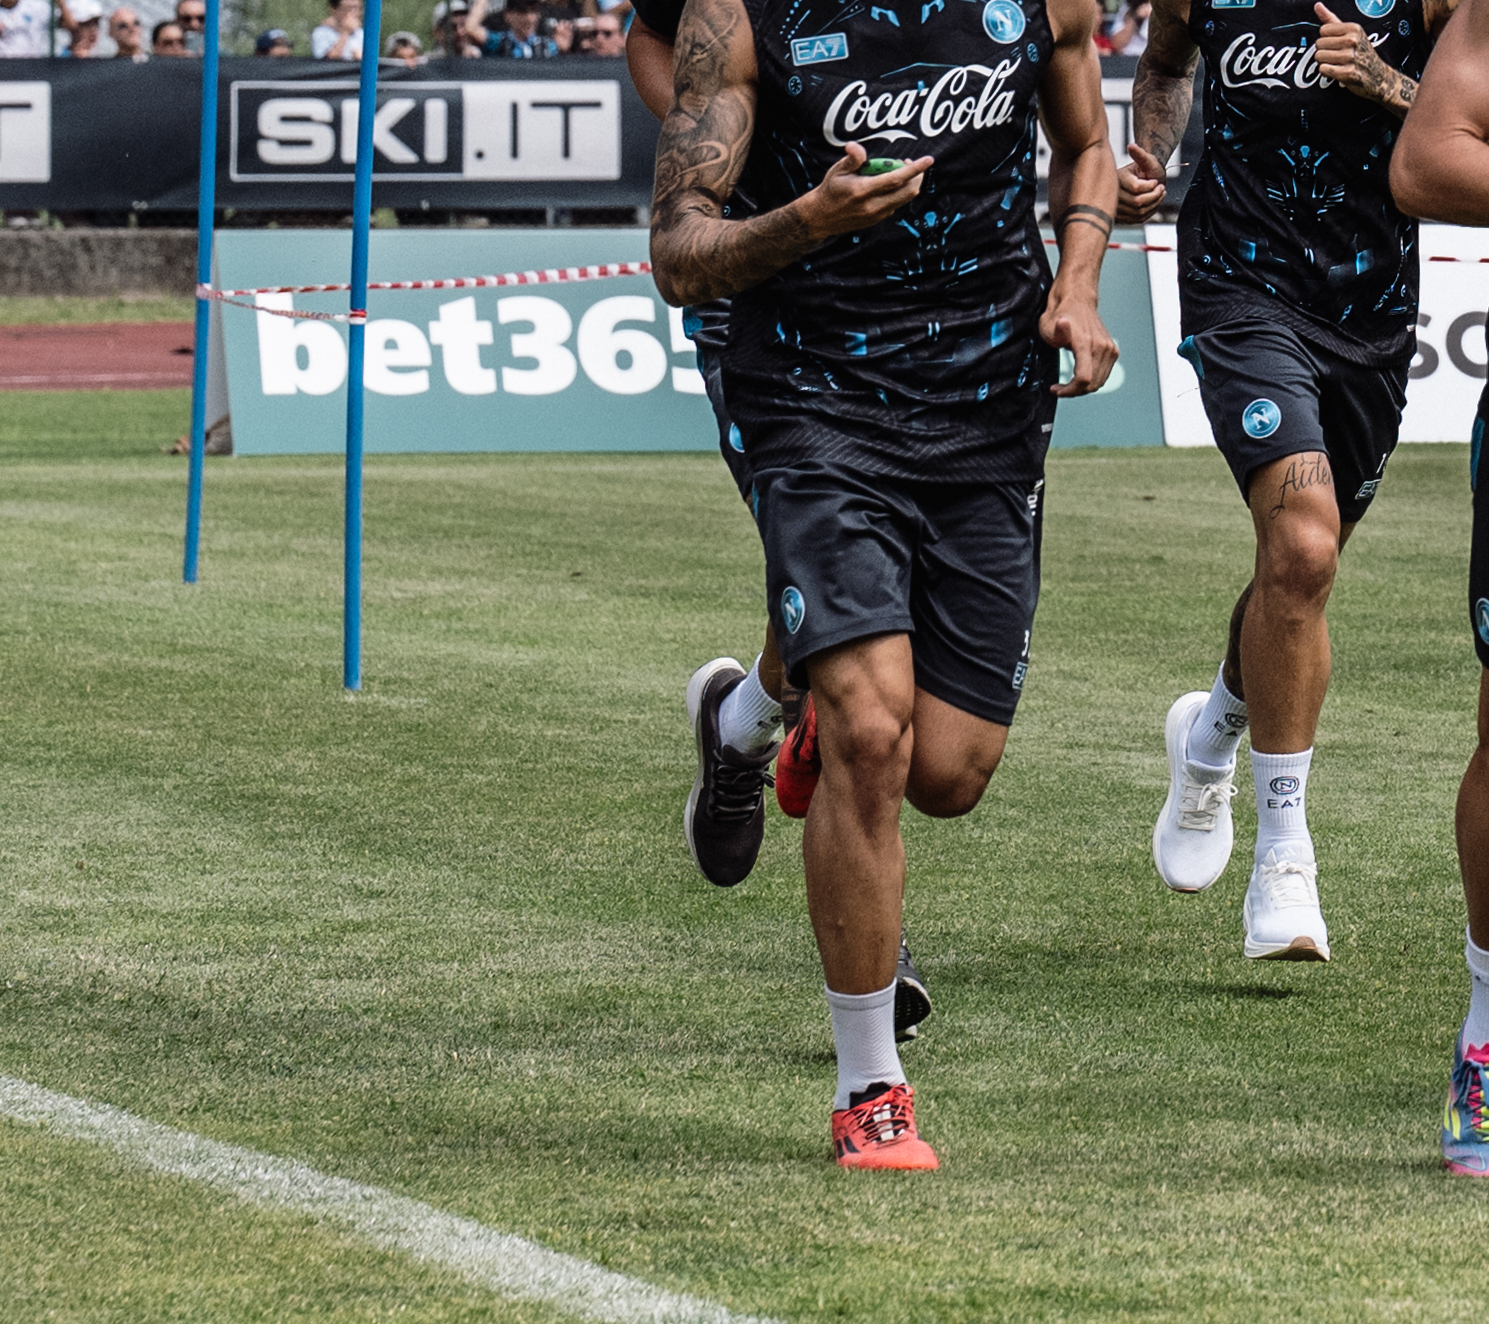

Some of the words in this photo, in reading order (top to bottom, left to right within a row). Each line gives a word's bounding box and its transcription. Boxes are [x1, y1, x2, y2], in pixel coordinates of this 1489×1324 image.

[794, 37, 840, 61] EA7
[1220, 32, 1391, 90] Coca-C
[823, 57, 1022, 147] Coca-Cola
[1267, 796, 1302, 809] EA7
